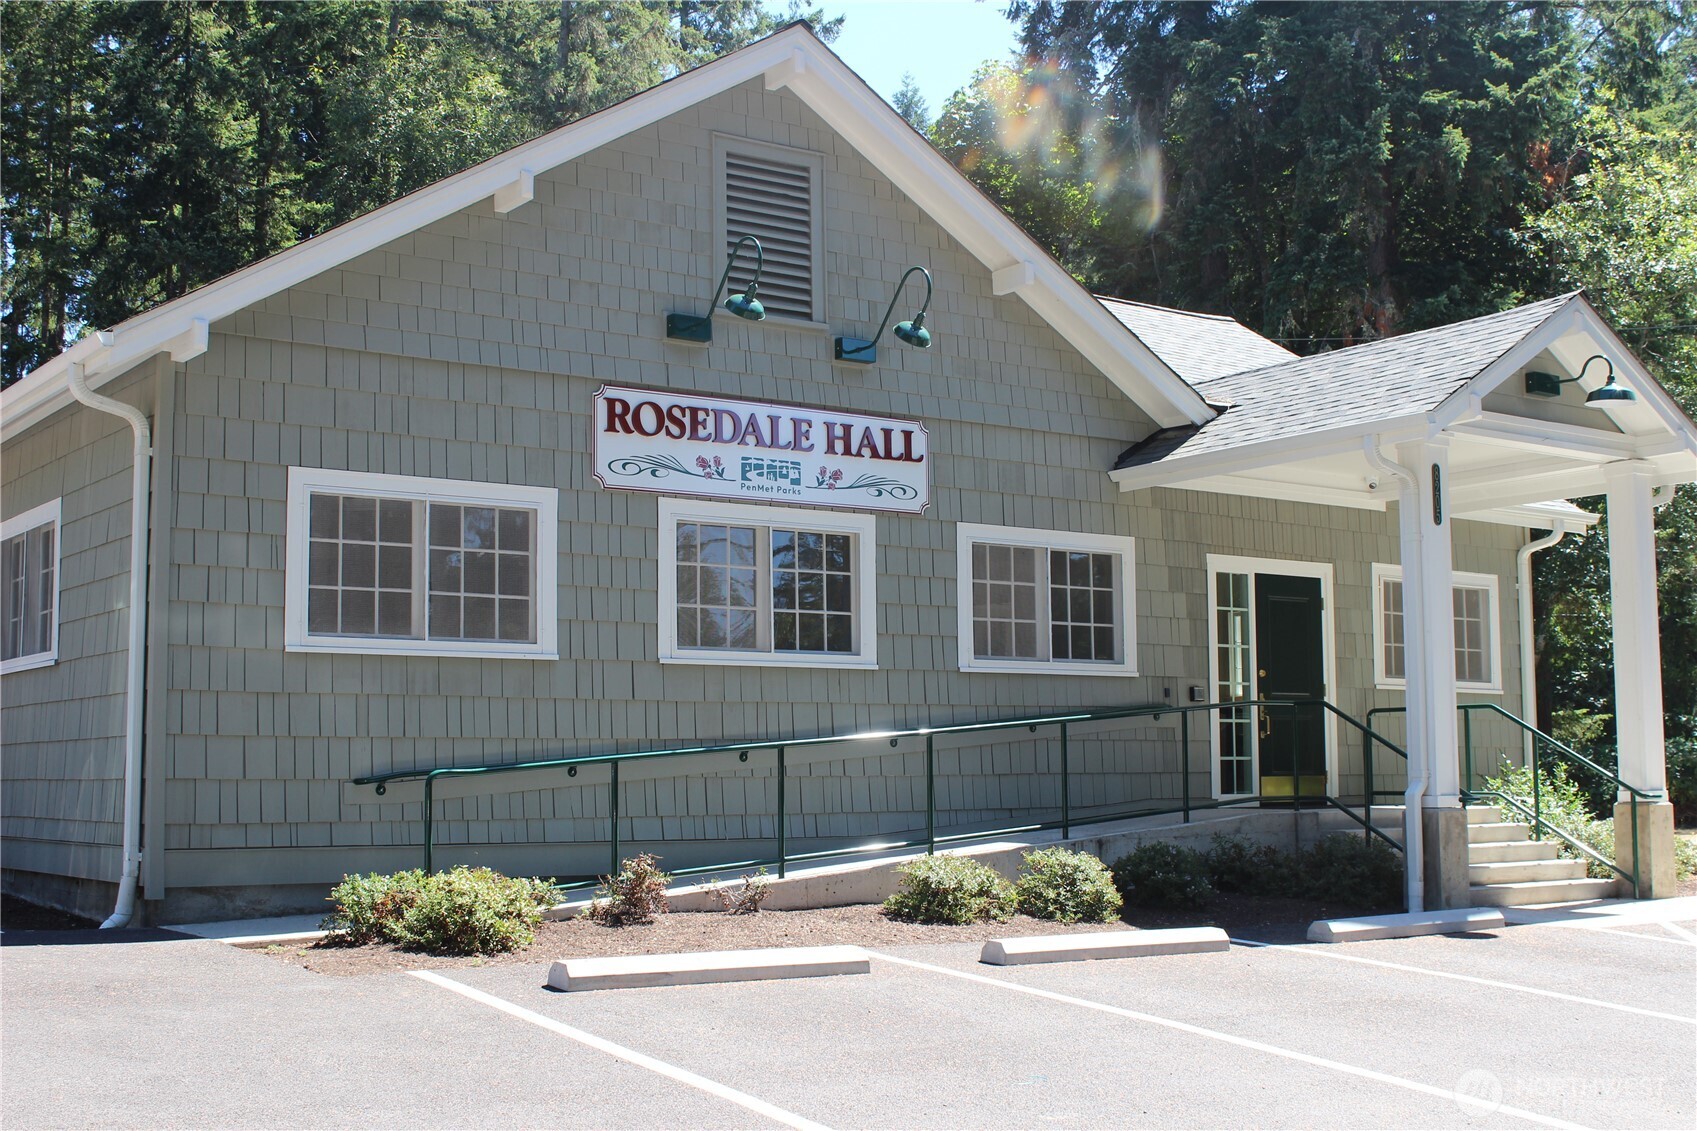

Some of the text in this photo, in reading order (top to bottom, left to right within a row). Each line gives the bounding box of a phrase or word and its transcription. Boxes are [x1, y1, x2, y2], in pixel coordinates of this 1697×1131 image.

[603, 397, 924, 463] ROSEDALE HALL
[740, 482, 802, 496] PenMet Parks
[1433, 465, 1441, 524] 8205
